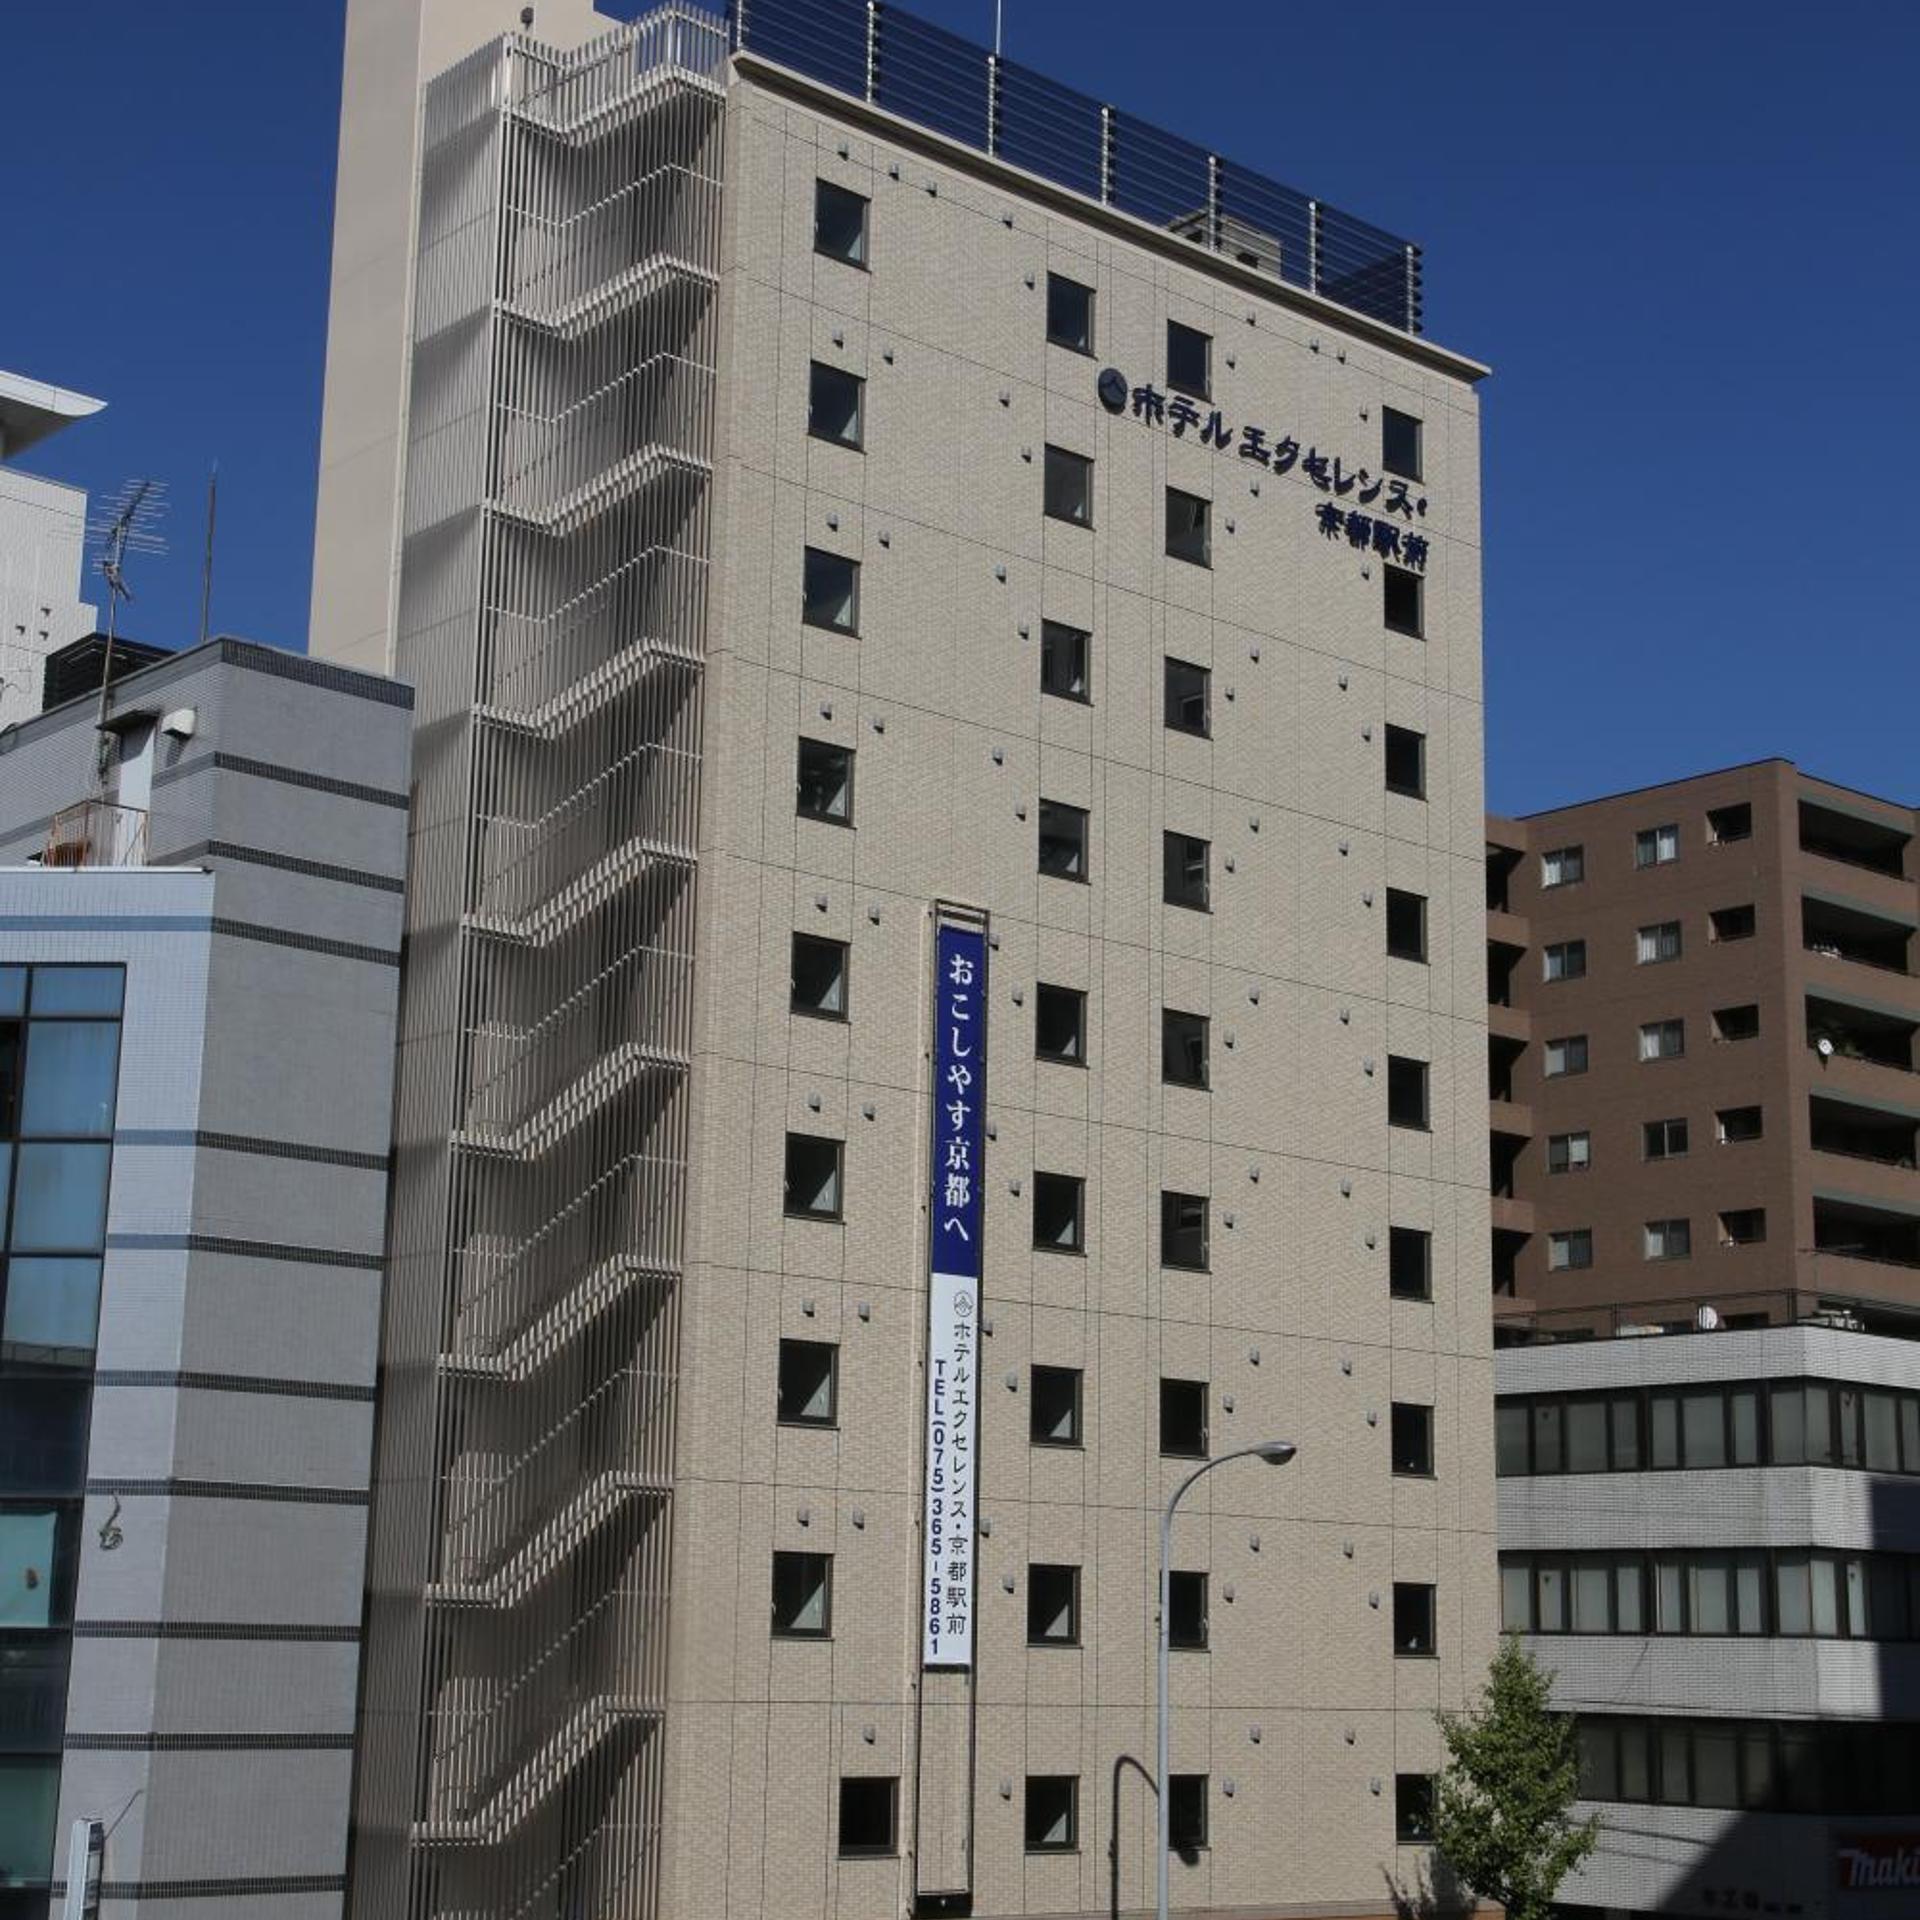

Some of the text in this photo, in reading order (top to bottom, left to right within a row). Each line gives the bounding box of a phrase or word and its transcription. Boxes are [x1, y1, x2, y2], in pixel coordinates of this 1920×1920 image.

[1315, 502, 1429, 571] 京都駅前
[944, 953, 974, 1241] おこしやす京都へ
[946, 1323, 972, 1636] ホテルエクセレンス・京都駅前
